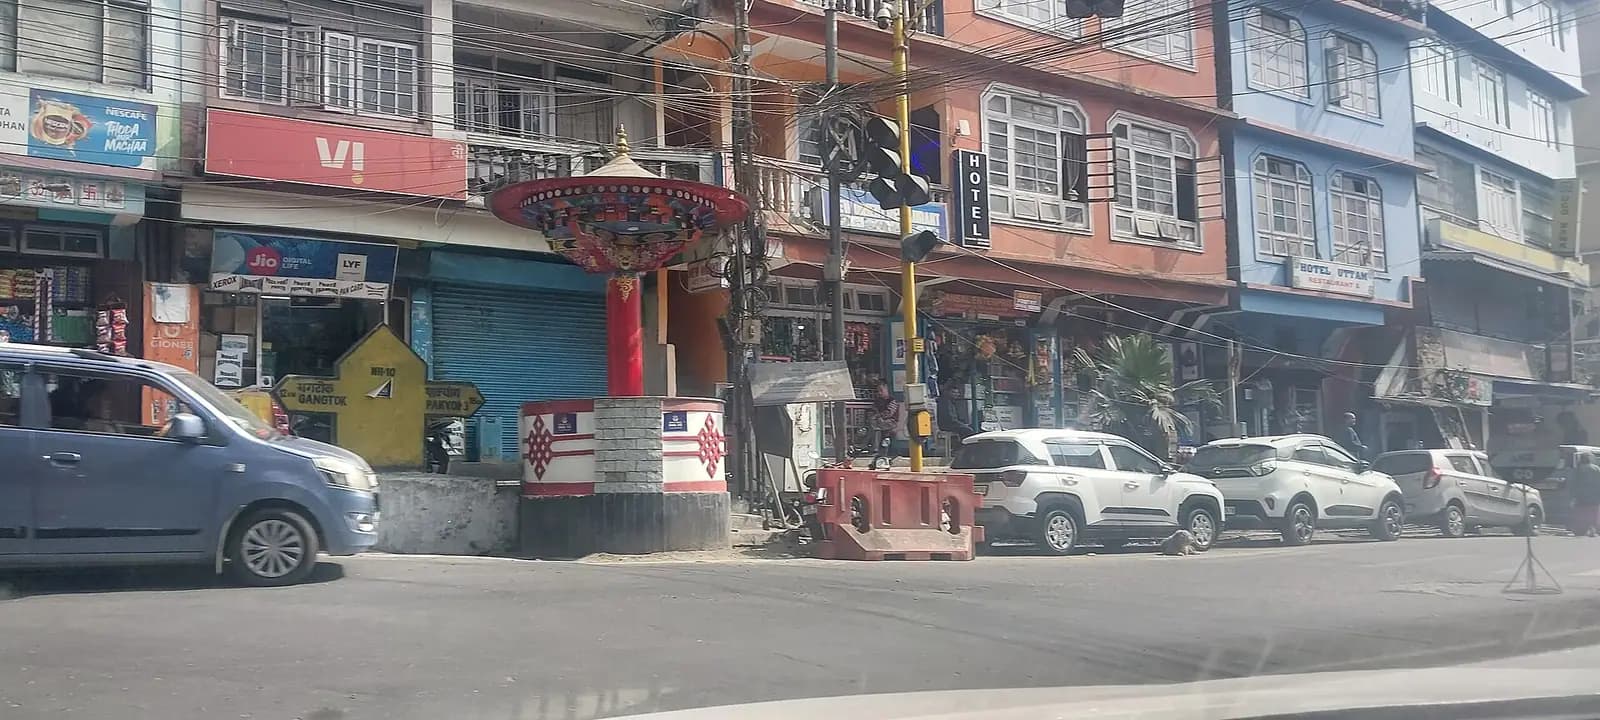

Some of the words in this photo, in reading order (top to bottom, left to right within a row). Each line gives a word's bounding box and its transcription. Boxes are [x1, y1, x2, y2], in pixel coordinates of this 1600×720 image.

[969, 154, 982, 236] HOTEL
[250, 253, 277, 268] Jio
[282, 256, 312, 265] DIGITAL
[343, 260, 361, 269] LYF
[1300, 263, 1330, 275] HOTEL
[1338, 268, 1368, 280] UTTAM
[213, 276, 238, 289] XEROX
[150, 340, 194, 350] GIONEE
[298, 394, 347, 406] GANGTOK
